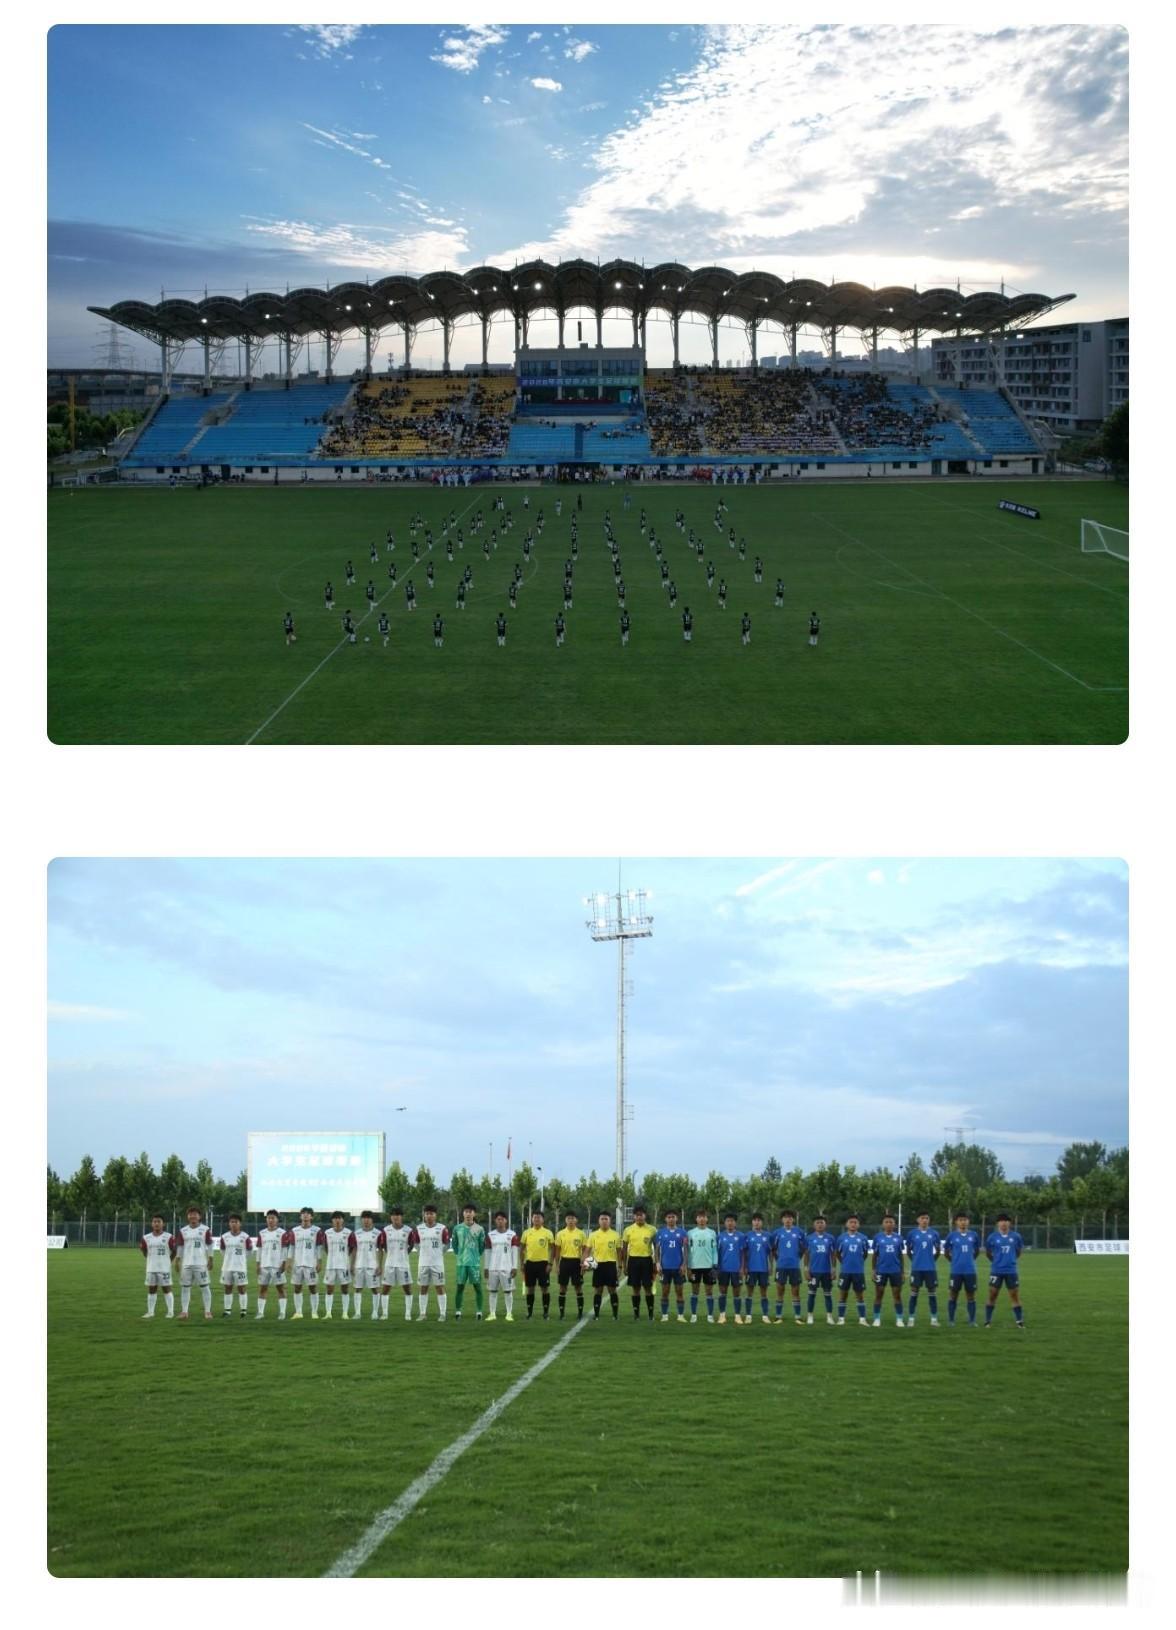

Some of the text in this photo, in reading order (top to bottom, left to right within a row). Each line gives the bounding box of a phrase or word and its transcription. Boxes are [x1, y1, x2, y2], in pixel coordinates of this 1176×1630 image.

[669, 1240, 676, 1248] 21
[728, 1243, 734, 1251] 3
[1001, 1246, 1010, 1254] 77
